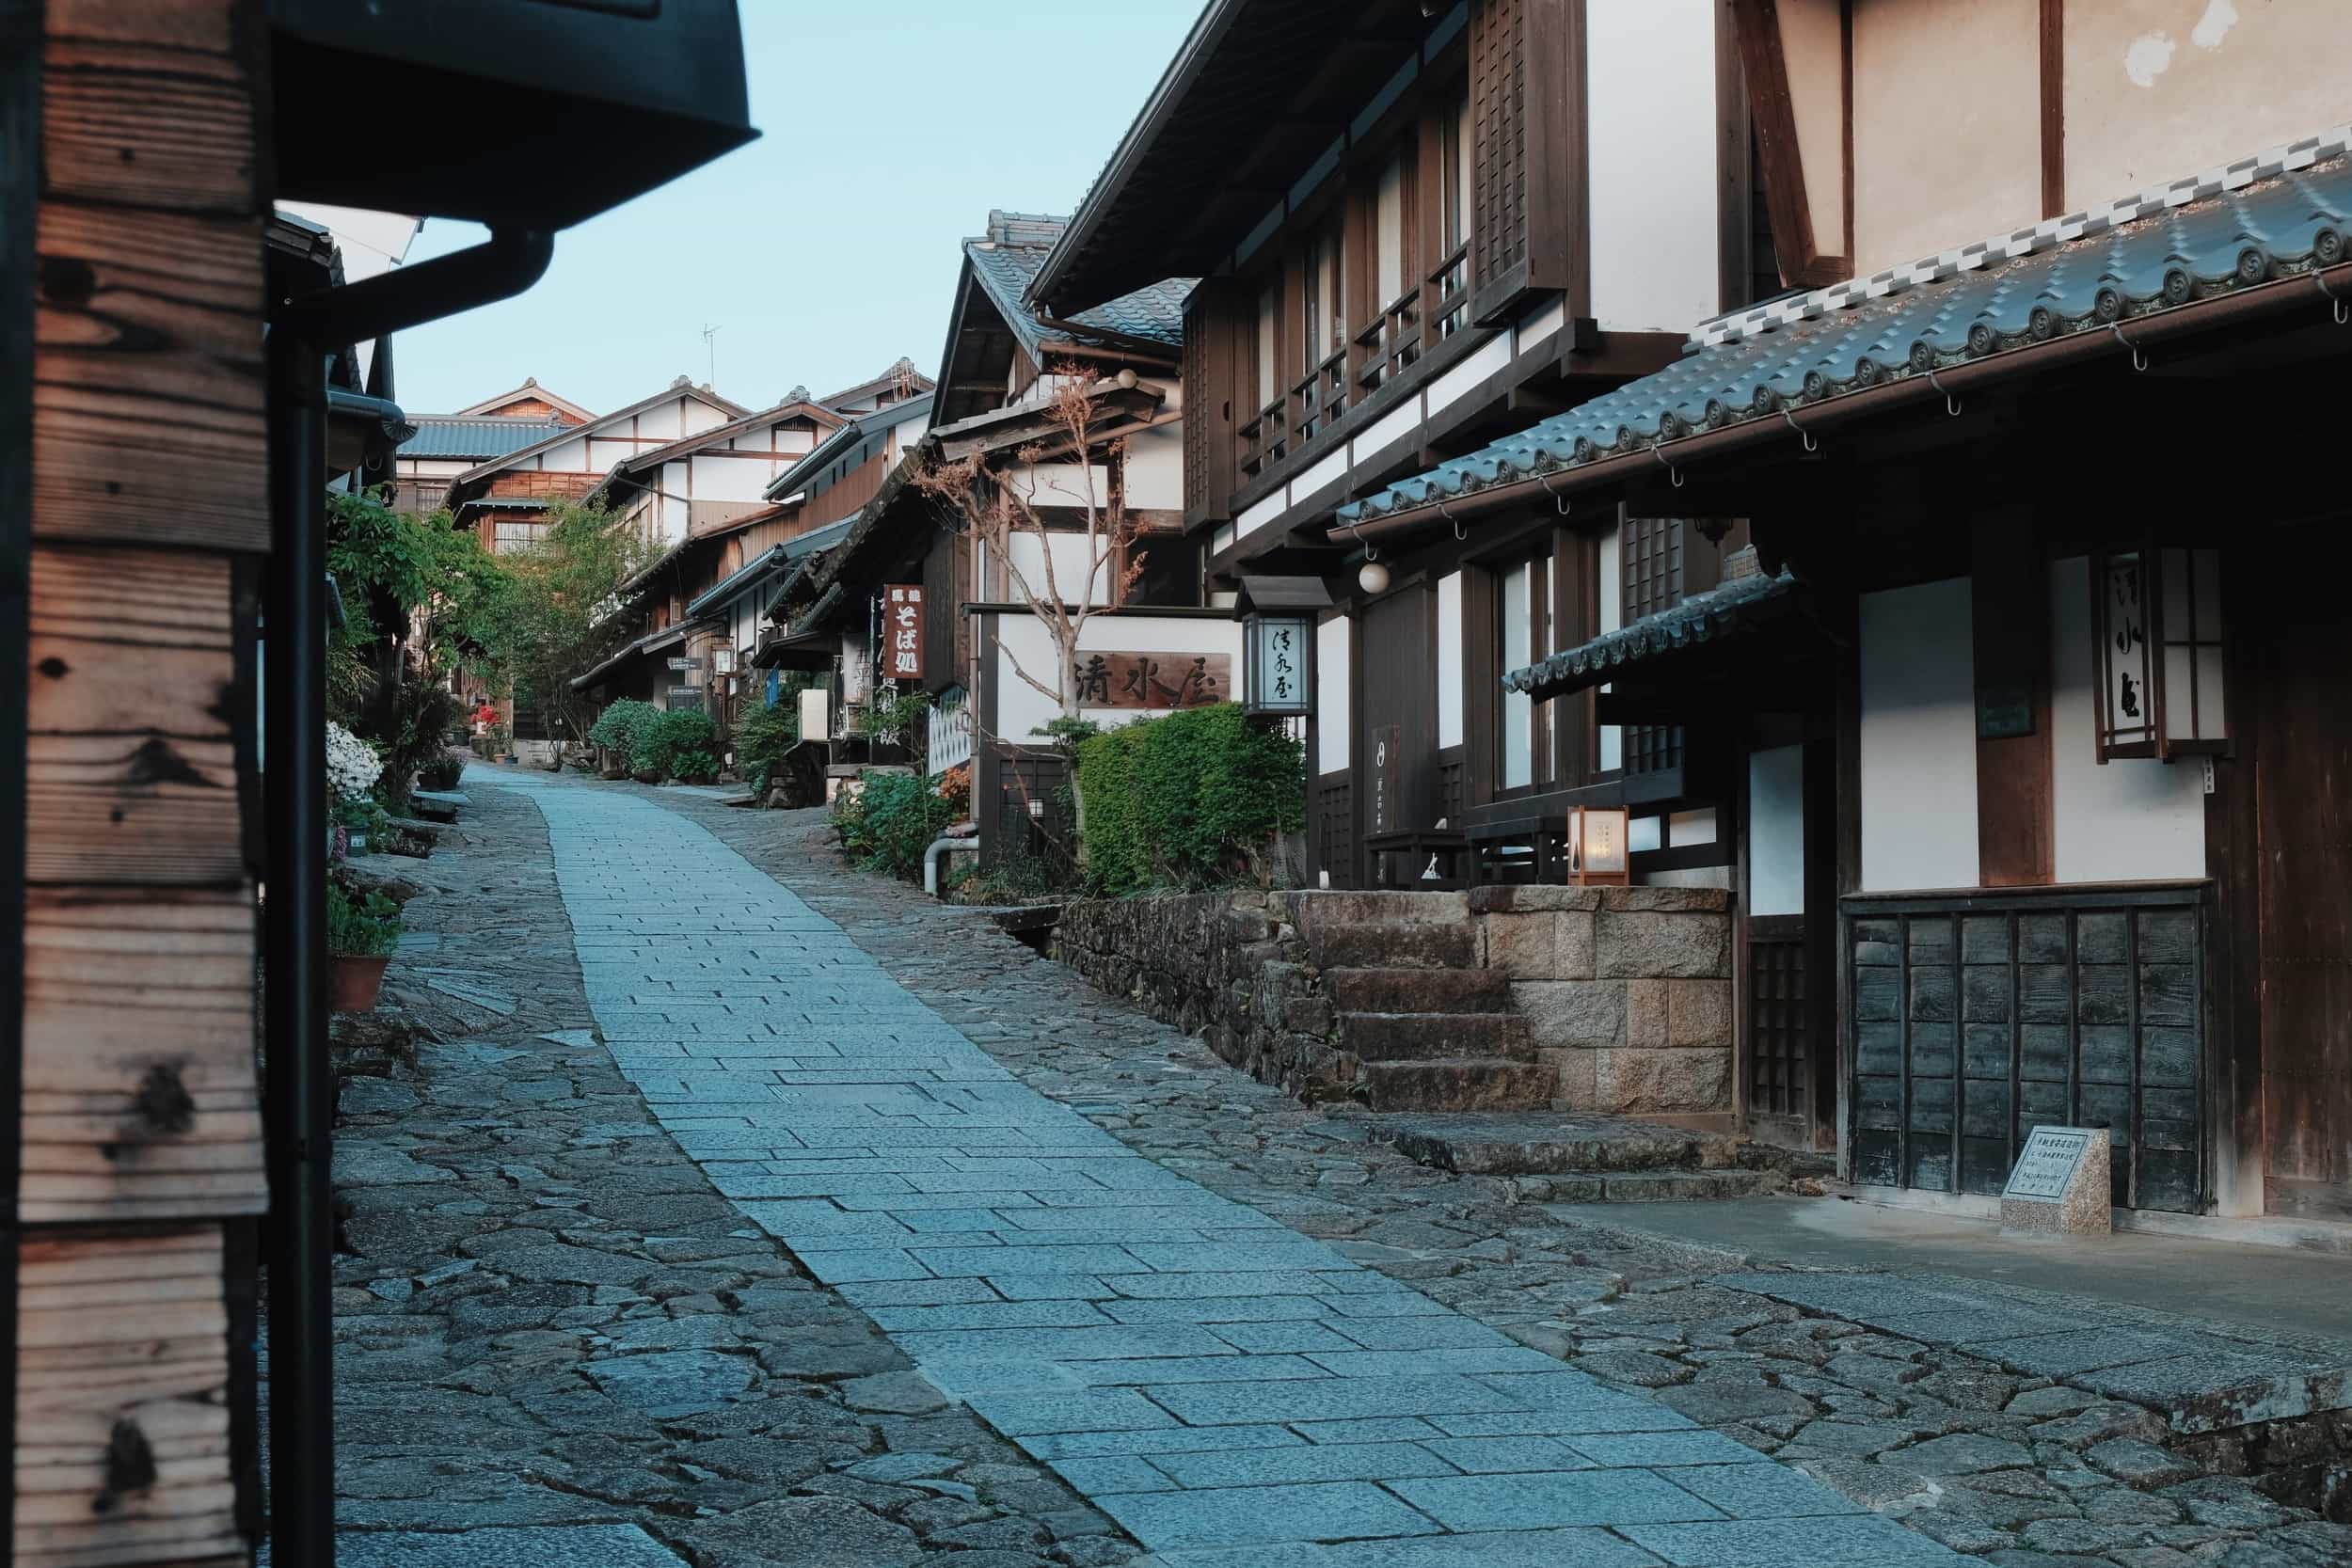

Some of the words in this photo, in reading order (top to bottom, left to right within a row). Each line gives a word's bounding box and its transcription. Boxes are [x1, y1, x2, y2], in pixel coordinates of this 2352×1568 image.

[896, 606, 917, 673] そば処
[1273, 628, 1292, 698] 清水屋
[1074, 655, 1219, 704] 清水屋
